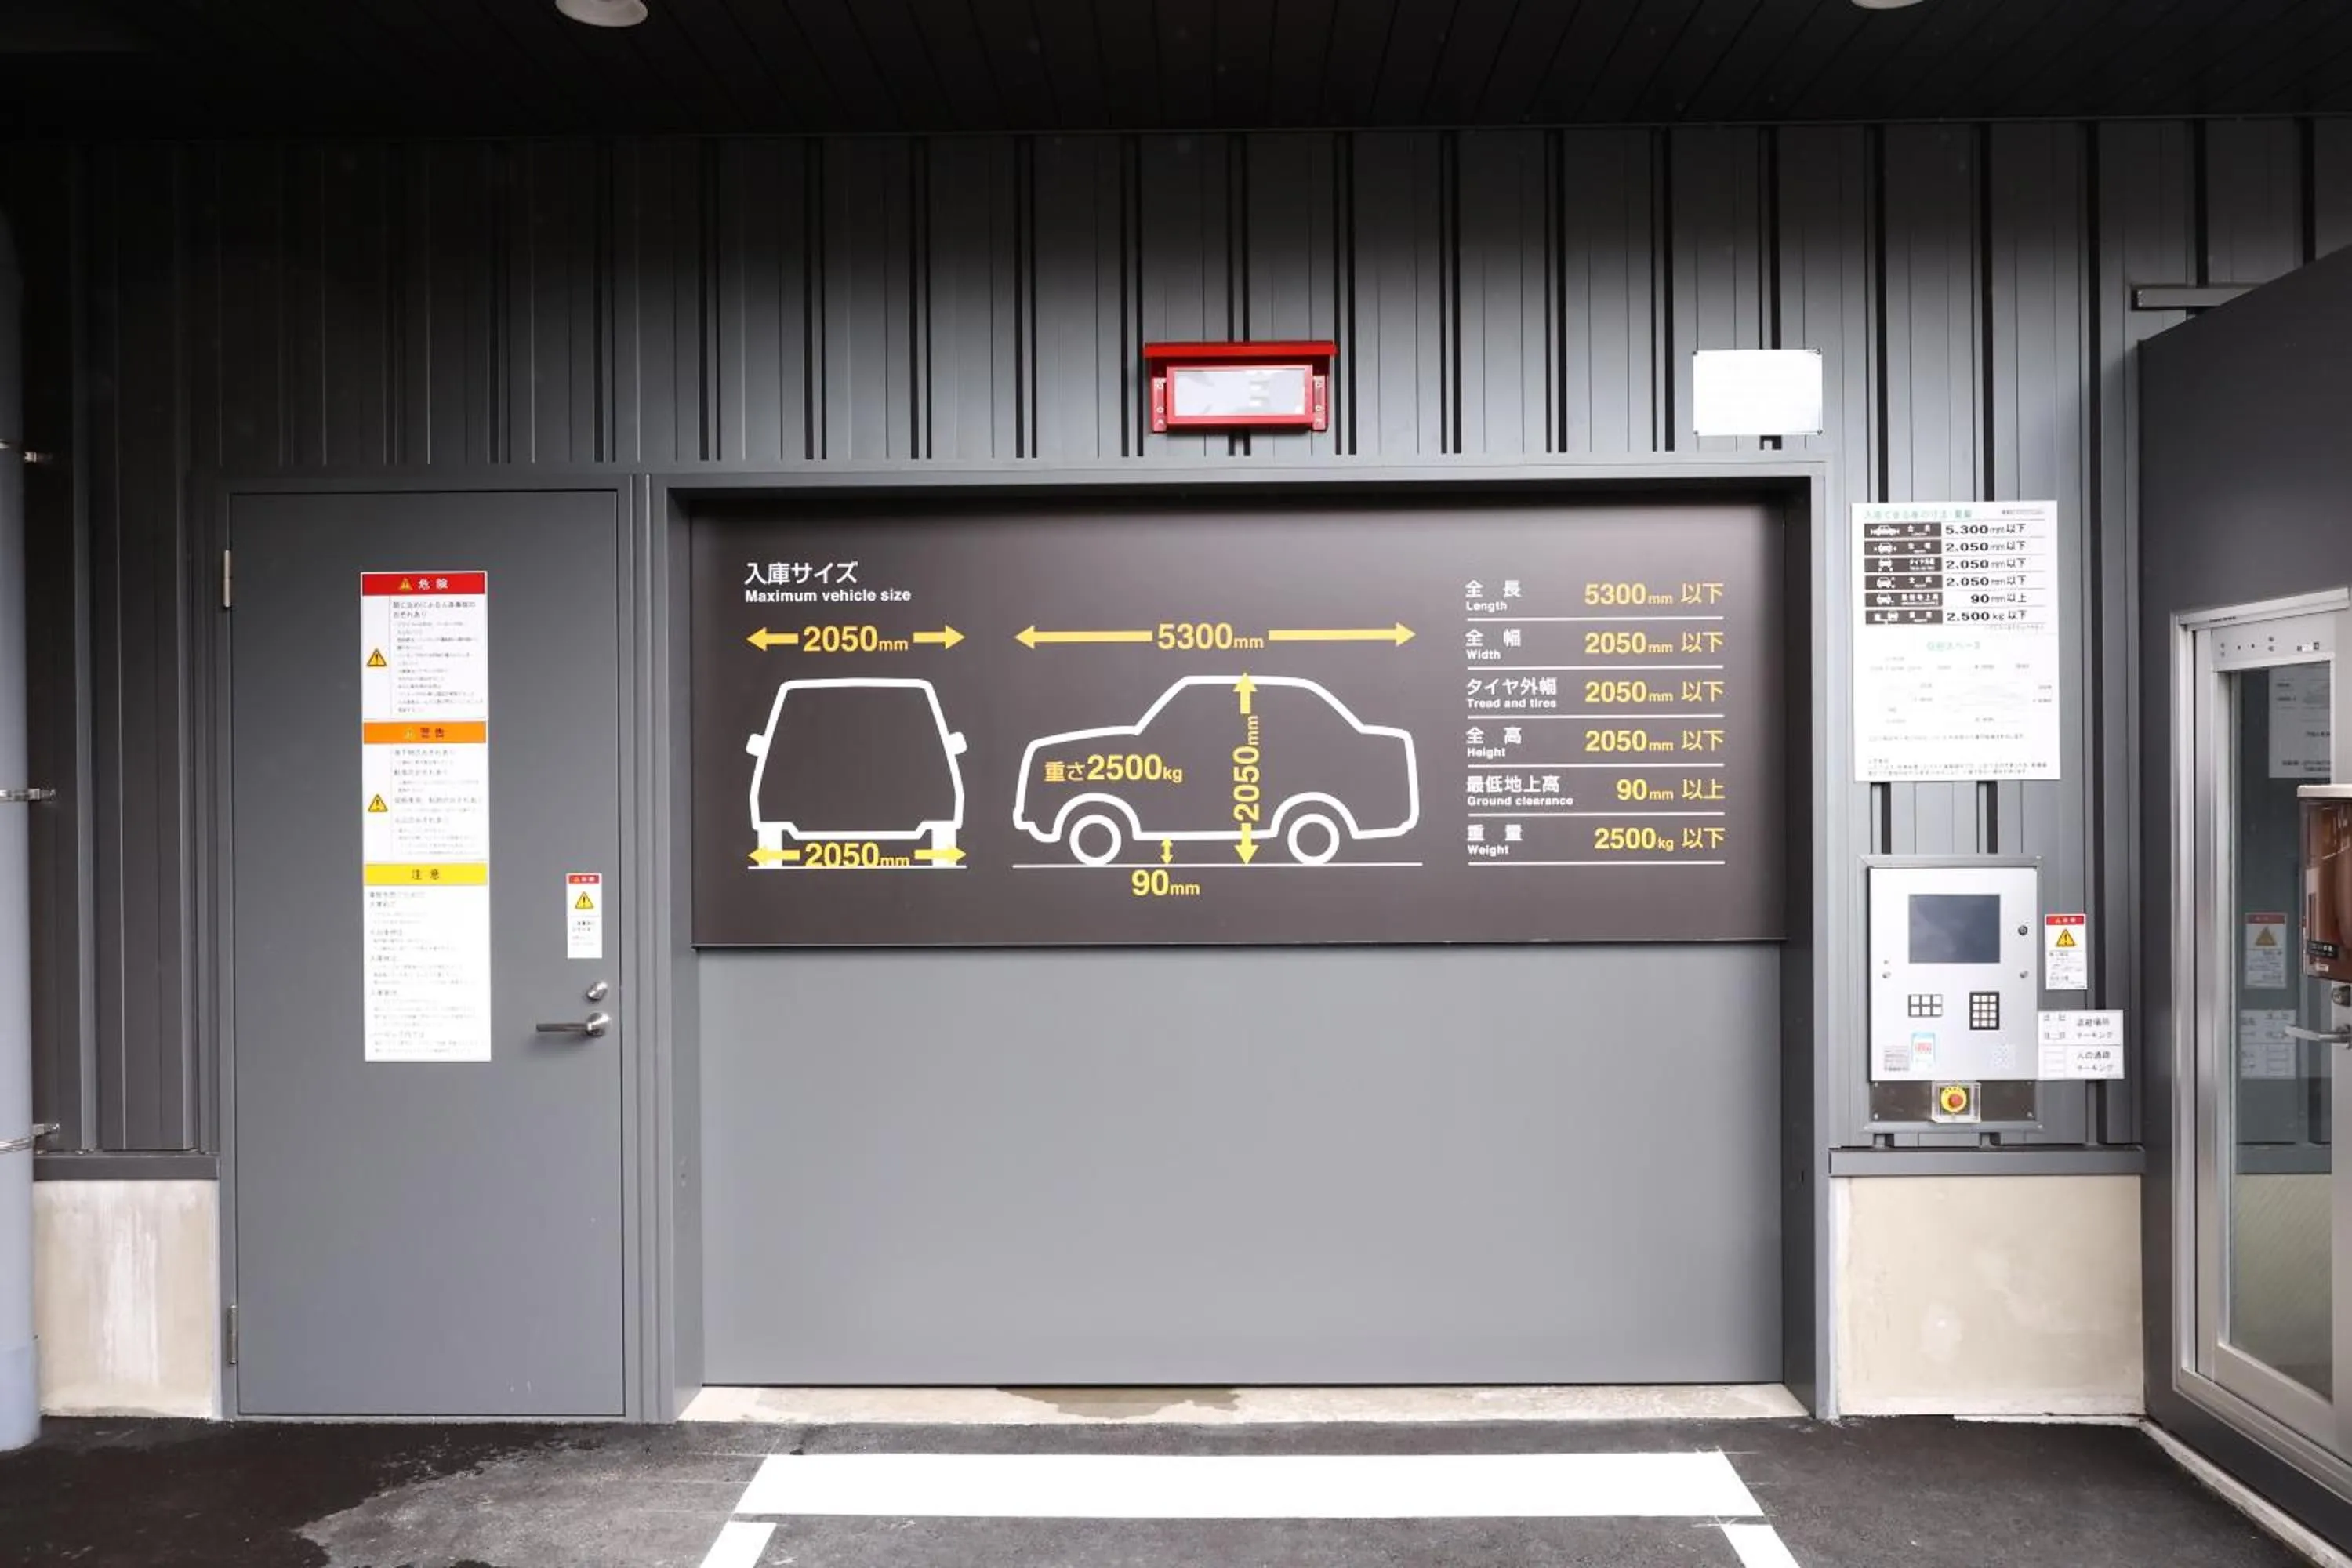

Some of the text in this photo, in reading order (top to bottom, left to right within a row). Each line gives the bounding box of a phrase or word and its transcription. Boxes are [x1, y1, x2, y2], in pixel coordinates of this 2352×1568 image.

[744, 561, 858, 585] 入庫サイズ
[746, 588, 912, 603] Maximum vehicle size
[1680, 583, 1724, 604] 以下
[1465, 601, 1508, 613] Length
[804, 625, 909, 652] 2050mm
[1158, 622, 1264, 650] 5300mm
[1681, 631, 1724, 653] 以下
[1466, 649, 1501, 659] Width
[1467, 677, 1557, 695] タイヤ外幅
[1681, 681, 1724, 702] 以下
[1467, 698, 1556, 709] Tread and tires
[1682, 730, 1724, 751] 以下
[1467, 747, 1506, 760] Height
[1232, 715, 1260, 821] 2050mm
[1466, 775, 1560, 793] 最低地上高
[1682, 779, 1726, 800] 以上
[1467, 796, 1573, 806] Ground clearance
[1682, 827, 1725, 849] 以下
[805, 842, 910, 866] 2050mm
[1467, 844, 1509, 857] Weight
[1131, 869, 1200, 896] 90mm
